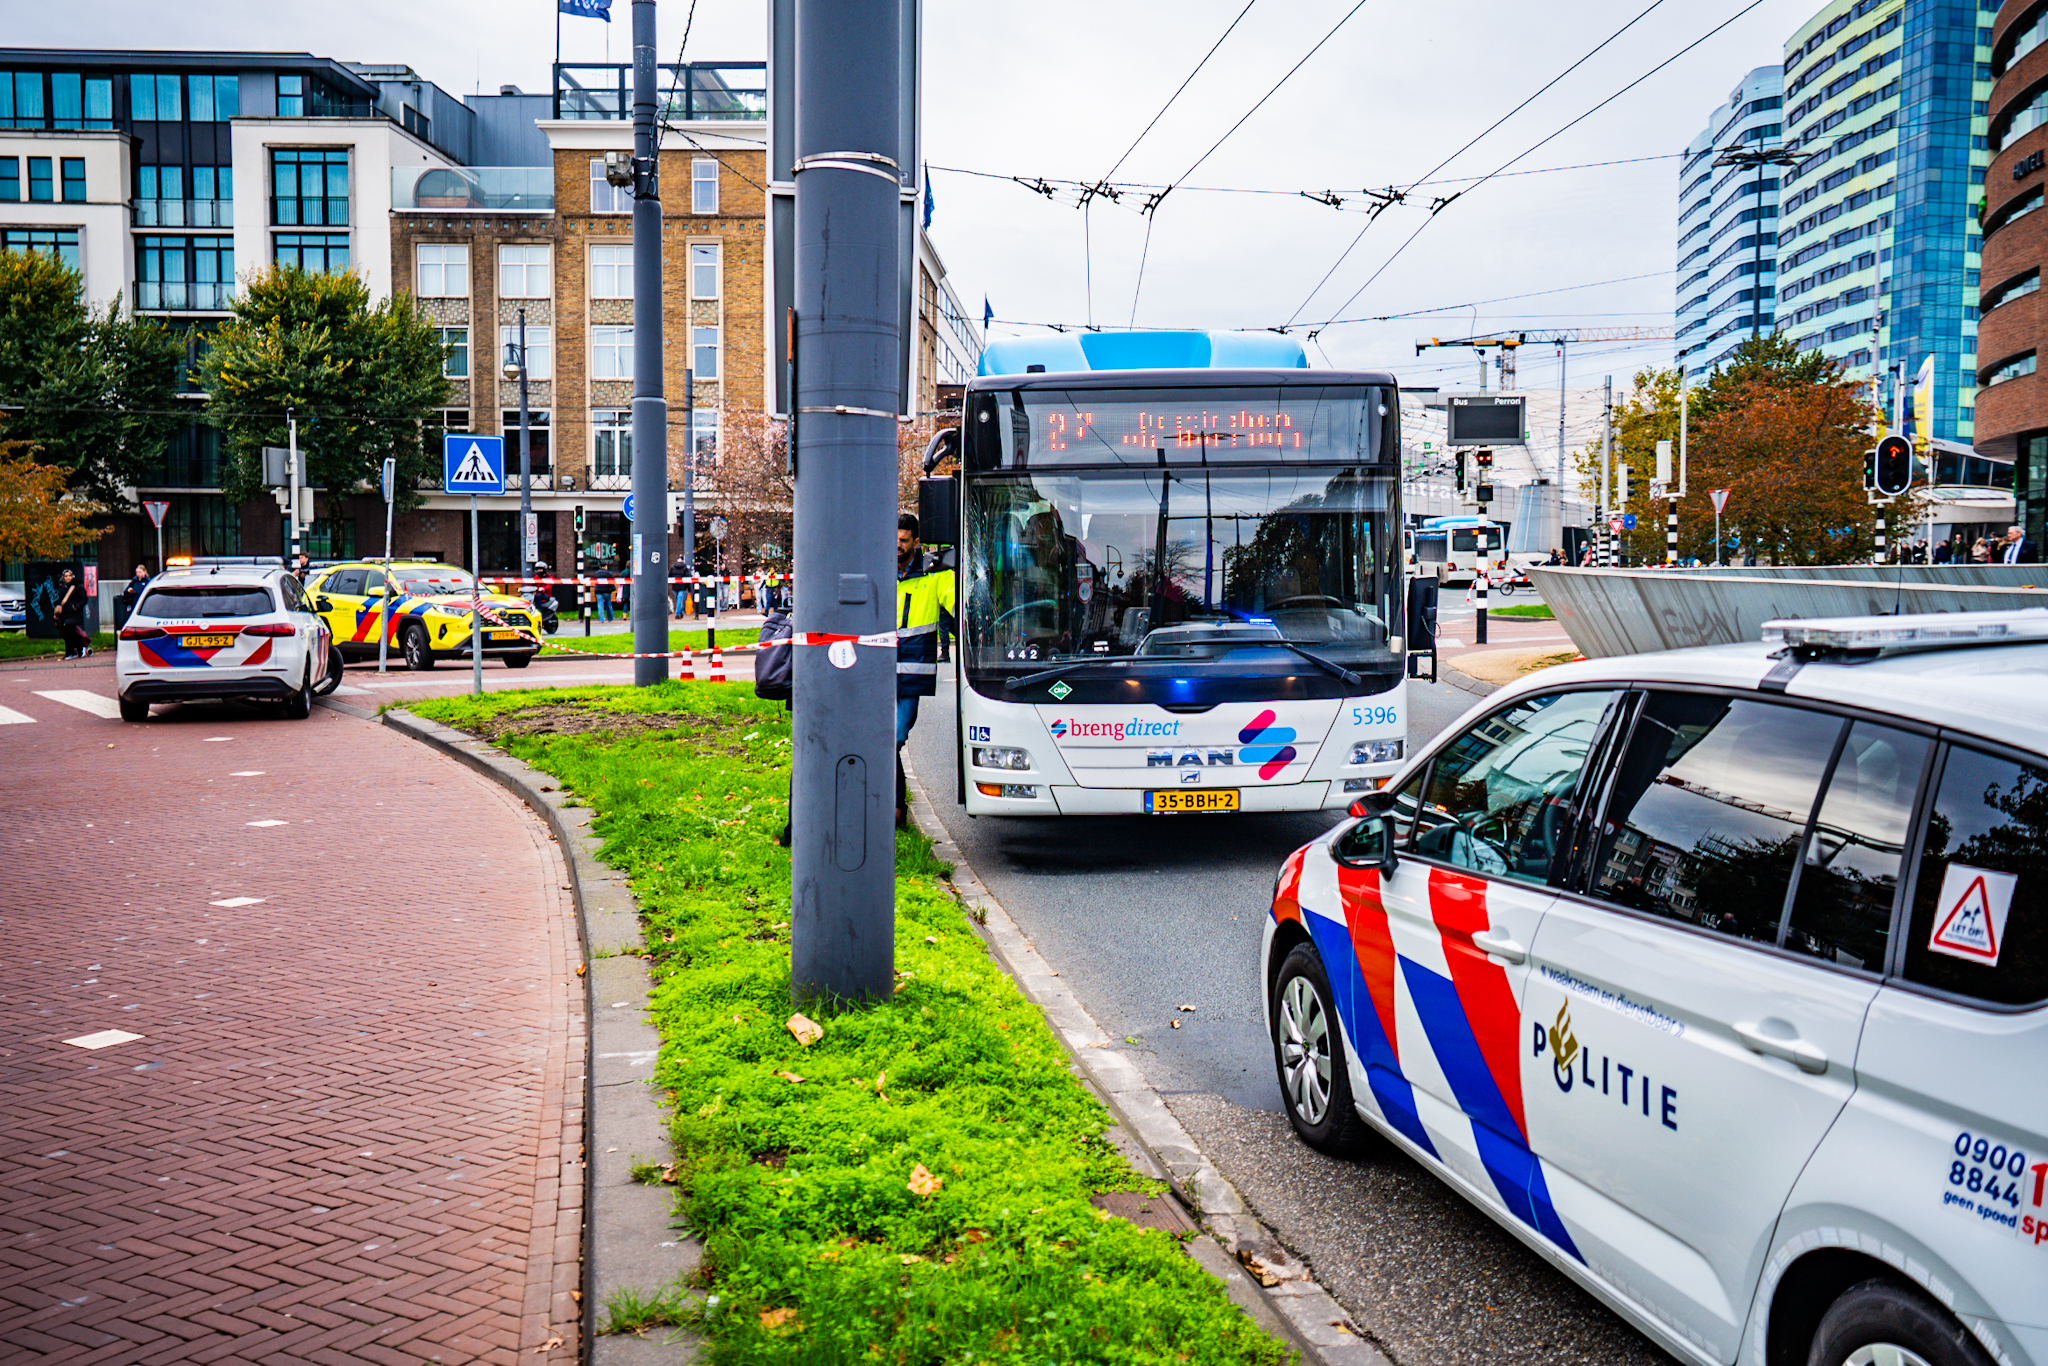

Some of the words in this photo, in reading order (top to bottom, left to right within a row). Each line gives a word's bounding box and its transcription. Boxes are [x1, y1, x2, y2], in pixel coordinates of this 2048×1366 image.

[2013, 149, 2044, 181] HOTEL
[1453, 398, 1468, 406] Bus
[186, 636, 229, 646] GJL-95-Z
[1053, 686, 1067, 694] CNG
[1353, 706, 1397, 726] 5396
[1070, 717, 1180, 741] brengdirect
[1146, 747, 1234, 767] MAN
[1158, 793, 1233, 808] 35-BBH-2
[1951, 922, 1966, 934] LET
[1533, 1021, 1678, 1132] POLITIE
[1954, 1132, 2026, 1178] 0900
[1949, 1160, 2019, 1208] 8844
[1943, 1191, 1974, 1212] geen
[1977, 1204, 2018, 1229] spoed
